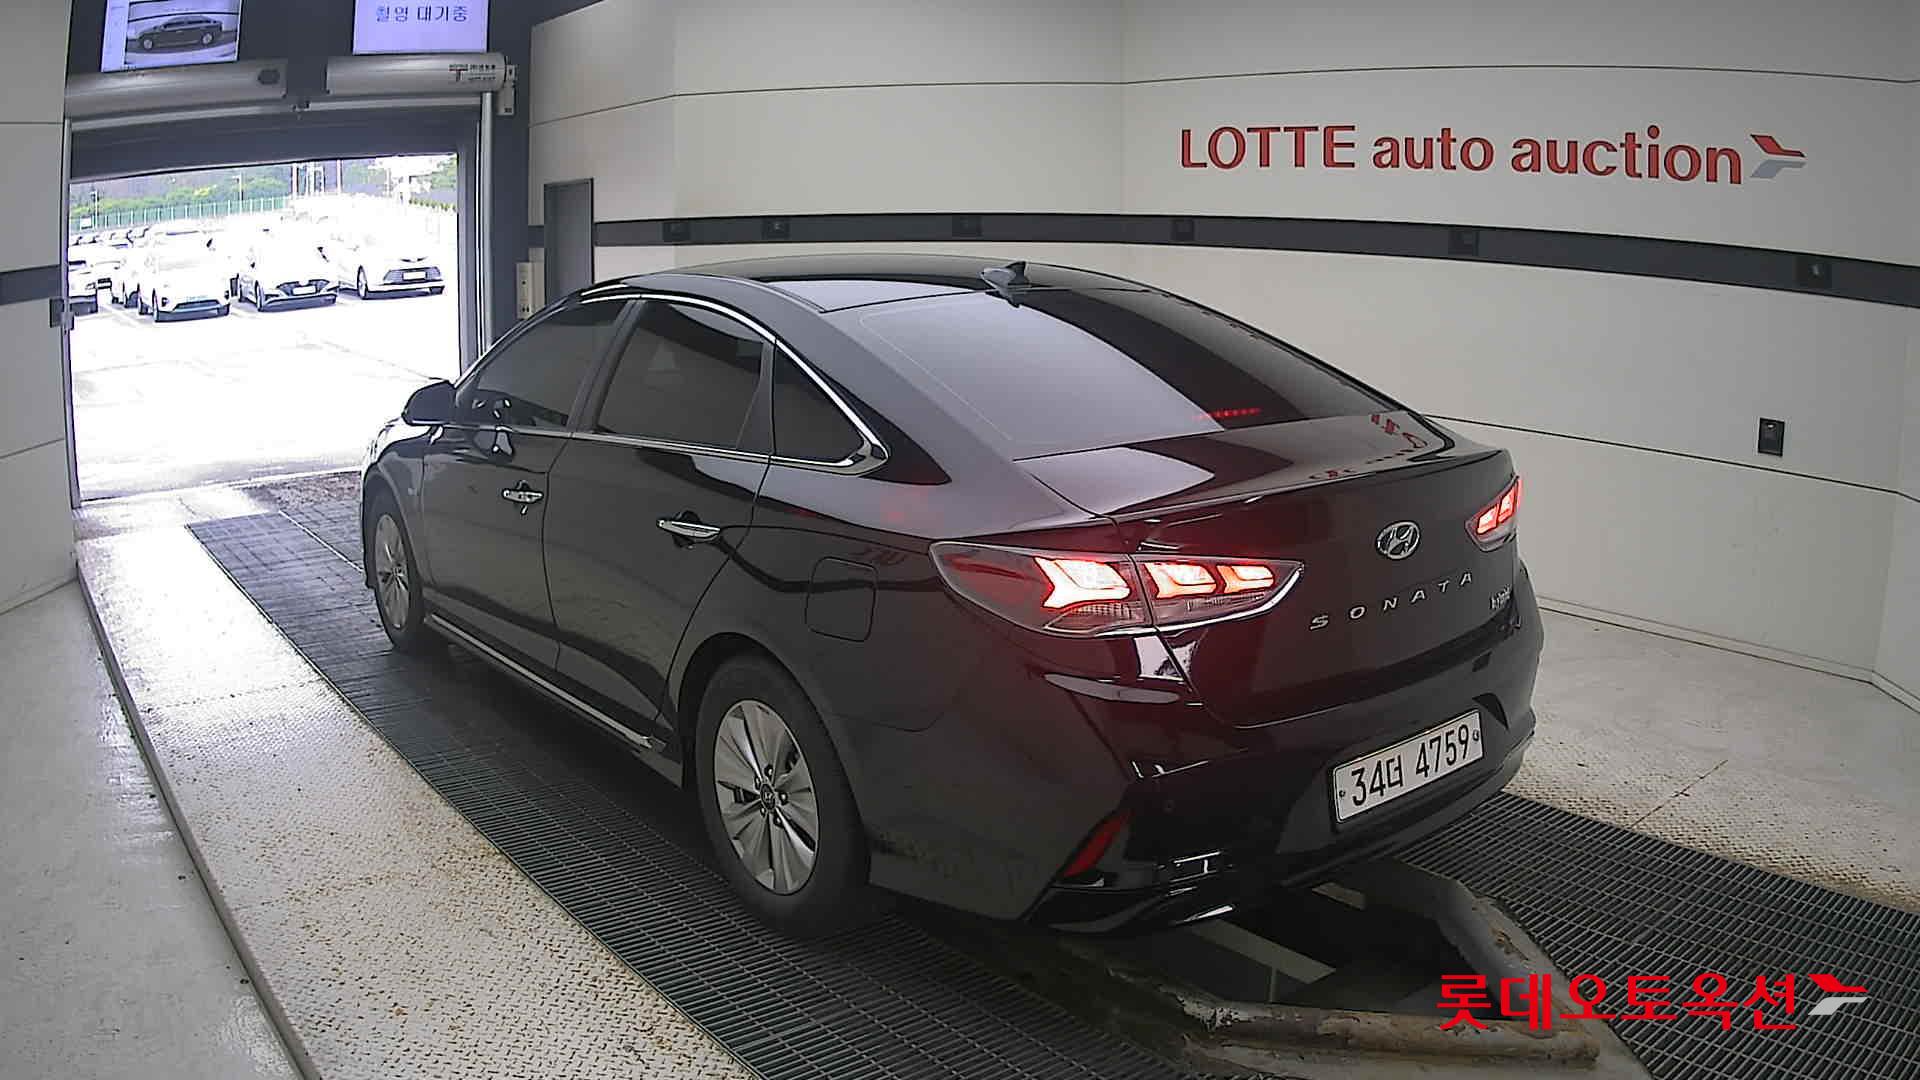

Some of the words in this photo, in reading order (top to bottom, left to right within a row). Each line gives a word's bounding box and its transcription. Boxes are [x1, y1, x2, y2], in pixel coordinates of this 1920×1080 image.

[417, 5, 468, 22] 대기중
[1181, 124, 1357, 169] LOTTE
[1372, 127, 1495, 171] auto
[1511, 124, 1743, 185] auction
[1309, 572, 1473, 630] SONATA
[1350, 757, 1404, 807] 34더
[1415, 723, 1470, 780] 4759
